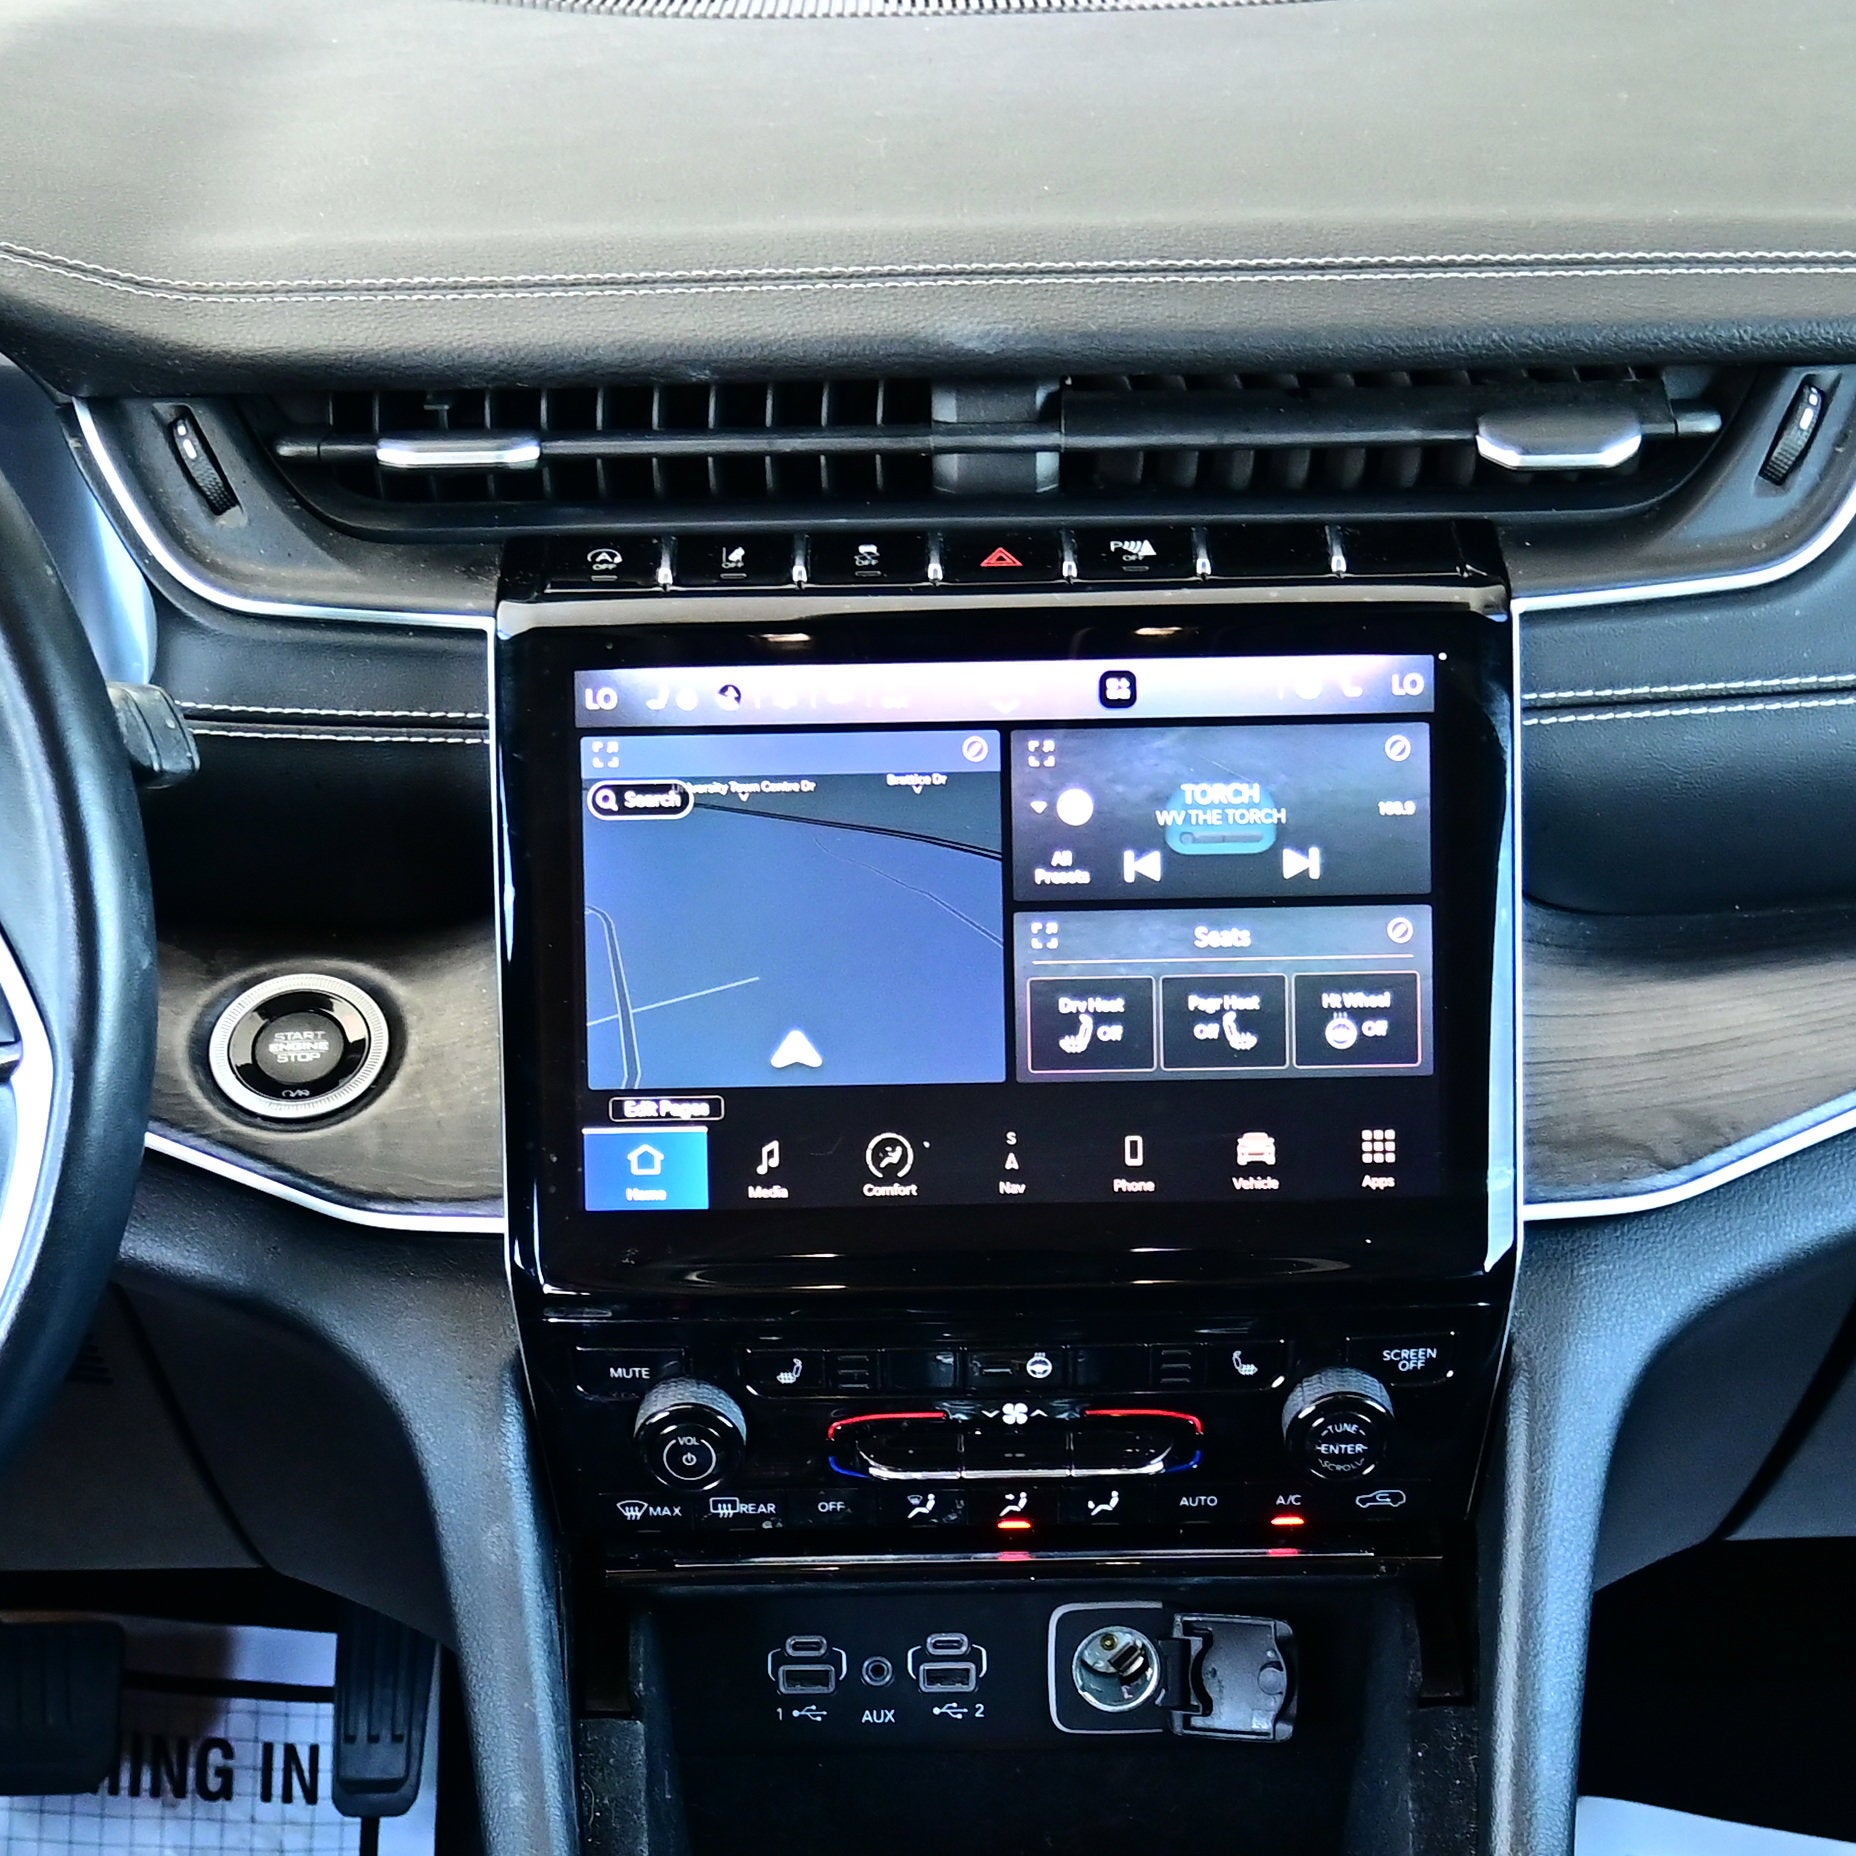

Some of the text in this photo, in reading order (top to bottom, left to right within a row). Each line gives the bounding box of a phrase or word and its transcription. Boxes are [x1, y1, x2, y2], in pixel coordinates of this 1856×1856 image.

[1391, 672, 1425, 697] LO
[584, 687, 618, 710] LO
[800, 779, 817, 793] Dr
[932, 772, 948, 786] Dr
[624, 788, 682, 809] Search
[1180, 781, 1261, 807] TORCH
[1155, 806, 1287, 828] WV THE TORCH
[1050, 849, 1072, 867] All
[1035, 866, 1091, 885] Presets
[1193, 925, 1252, 949] Seats
[1058, 996, 1125, 1014] Drv Heat
[1224, 993, 1261, 1011] Heat
[1342, 991, 1392, 1009] Wheel
[274, 1031, 326, 1042] START
[1096, 1024, 1124, 1042] Off
[1193, 1022, 1221, 1040] Off
[1361, 1020, 1389, 1038] Off
[268, 1041, 330, 1053] ENGINE
[276, 1052, 321, 1064] STOP
[623, 1099, 710, 1120] Edit Pages
[863, 1182, 918, 1198] Comfort
[999, 1181, 1026, 1195] Nav
[1113, 1178, 1155, 1194] Phone
[1232, 1176, 1280, 1191] Vehicle
[1361, 1175, 1396, 1191] Apps
[625, 1187, 667, 1202] Home
[748, 1184, 789, 1200] Media
[1382, 1348, 1437, 1362] SCREEN
[609, 1367, 650, 1380] MUTE
[1397, 1360, 1425, 1373] OFF
[1327, 1422, 1360, 1435] TUNE
[677, 1436, 700, 1446] VOL
[1320, 1443, 1364, 1456] ENTER
[739, 1503, 776, 1514] REAR
[818, 1501, 845, 1513] OFF
[1179, 1496, 1218, 1508] AUTO
[1275, 1495, 1302, 1507] A/C
[649, 1506, 682, 1517] MAX
[776, 1707, 784, 1721] 1
[861, 1710, 896, 1725] AUX
[974, 1704, 985, 1718] 2
[260, 1740, 320, 1806] IN
